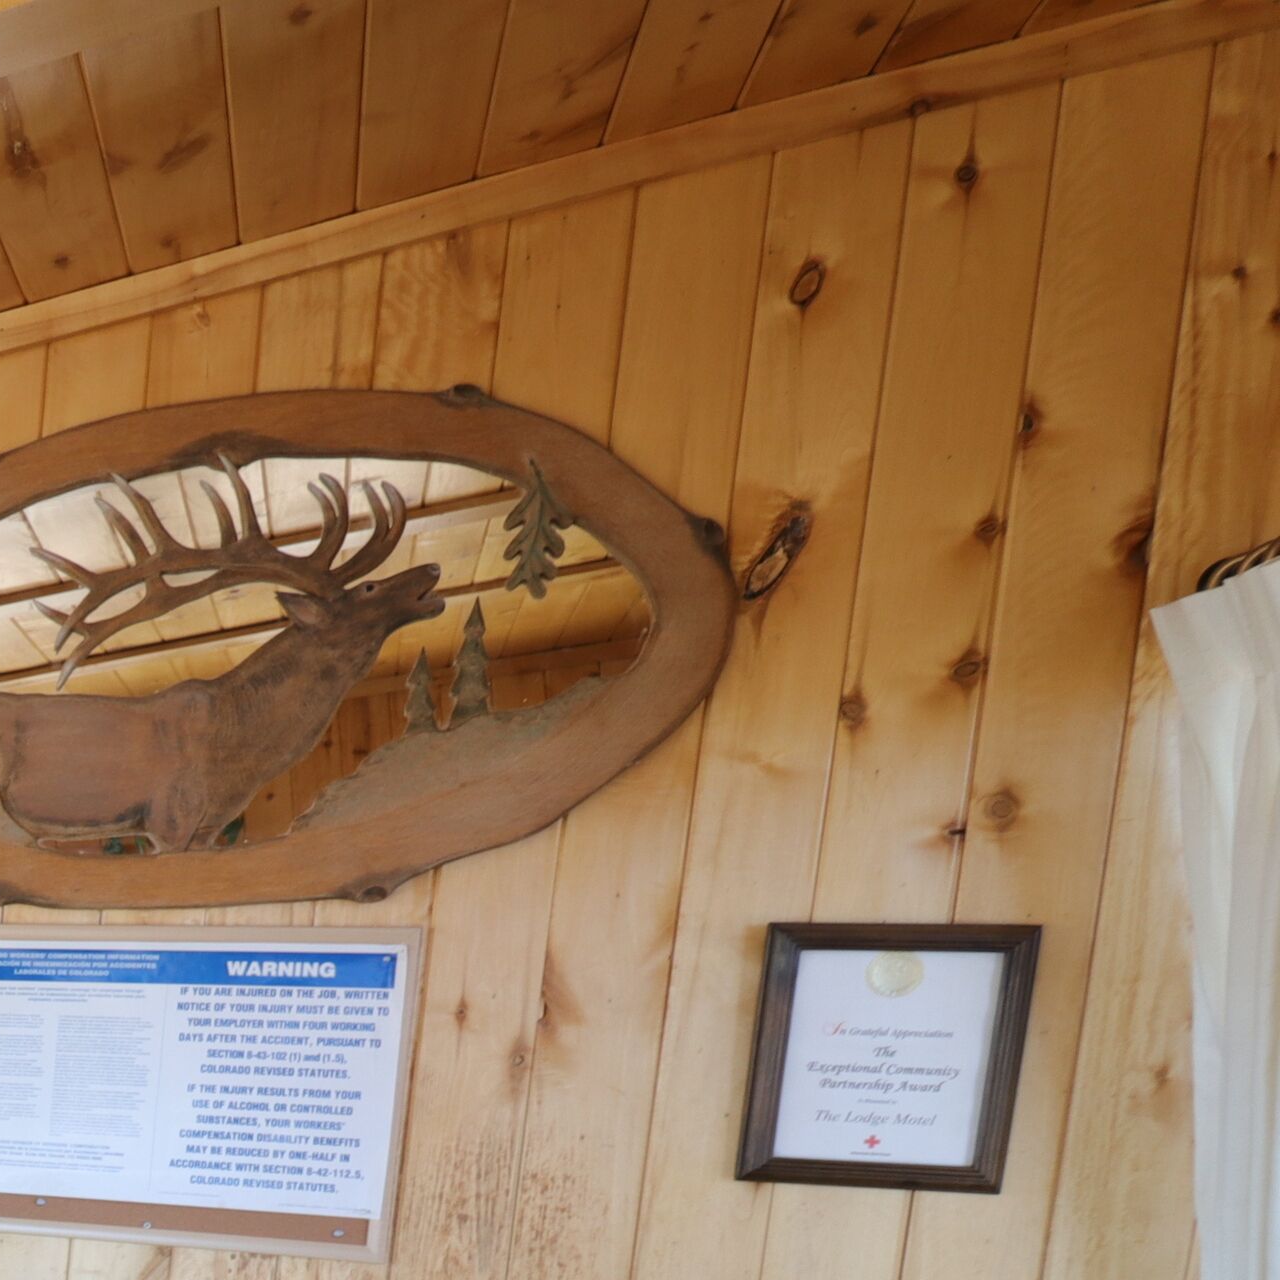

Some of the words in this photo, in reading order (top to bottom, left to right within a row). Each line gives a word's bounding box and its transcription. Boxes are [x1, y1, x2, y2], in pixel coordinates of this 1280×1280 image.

[226, 960, 337, 978] WARNING
[181, 987, 189, 995] IF
[193, 987, 211, 996] YOU
[214, 988, 232, 996] ARE
[236, 989, 276, 997] INJURED
[280, 989, 293, 998] ON
[296, 990, 315, 998] THE
[318, 990, 340, 1000] JOB,
[344, 991, 389, 1000] WRITTEN
[177, 1002, 210, 1011] NOTICE
[214, 1003, 227, 1012] OF
[230, 1003, 255, 1012] YOUR
[258, 1004, 293, 1013] INJURY
[296, 1005, 324, 1014] MUST
[328, 1006, 340, 1015] BE
[343, 1007, 374, 1016] GIVEN
[377, 1007, 389, 1016] TO
[188, 1018, 211, 1027] YOUR
[214, 1018, 264, 1028] EMPLOYER
[267, 1020, 300, 1029] WITHIN
[303, 1021, 328, 1030] FOUR
[331, 1022, 375, 1032] WORKING
[849, 1027, 889, 1038] Grateful
[891, 1028, 954, 1039] Appreciation
[179, 1033, 203, 1042] DAYS
[206, 1034, 237, 1043] AFTER
[240, 1035, 257, 1044] THE
[260, 1035, 313, 1047] ACCIDENT,
[317, 1038, 366, 1048] PURSUANT
[369, 1039, 381, 1048] TO
[207, 1049, 244, 1058] SECTION
[289, 1051, 301, 1062] (1)
[304, 1053, 320, 1062] and
[872, 1046, 897, 1057] The
[200, 1064, 251, 1075] COLORADO
[254, 1066, 295, 1076] REVISED
[298, 1067, 351, 1079] STATUTES.
[806, 1061, 886, 1075] Exceptional
[886, 1063, 961, 1080] Community
[187, 1084, 197, 1092] IF
[200, 1084, 216, 1093] THE
[220, 1085, 254, 1094] INJURY
[257, 1087, 299, 1097] RESULTS
[302, 1089, 331, 1098] FROM
[335, 1090, 361, 1100] YOUR
[819, 1078, 894, 1094] Partnership
[895, 1081, 945, 1092] Award
[192, 1099, 210, 1108] USE
[213, 1100, 224, 1109] OF
[227, 1100, 269, 1111] ALCOHOL
[274, 1102, 287, 1112] OR
[290, 1103, 353, 1115] CONTROLLED
[196, 1115, 261, 1127] SUBSTANCES,
[265, 1117, 290, 1127] YOUR
[294, 1119, 345, 1131] WORKERS'
[815, 1110, 840, 1122] The
[844, 1111, 889, 1126] Lodge
[892, 1113, 937, 1126] Motel
[179, 1129, 254, 1141] COMPENSATION
[257, 1132, 310, 1144] DISABILITY
[313, 1135, 360, 1147] BENEFITS
[186, 1145, 207, 1154] MAY
[211, 1146, 222, 1155] BE
[225, 1147, 269, 1157] REDUCED
[273, 1149, 285, 1158] BY
[289, 1150, 336, 1161] ONE-HALF
[340, 1153, 349, 1162] IN
[169, 1159, 232, 1171] ACCORDANCE
[235, 1162, 260, 1172] WITH
[263, 1164, 303, 1175] SECTION
[190, 1175, 240, 1186] COLORADO
[243, 1178, 283, 1189] REVISED
[286, 1180, 339, 1193] STATUTES.
